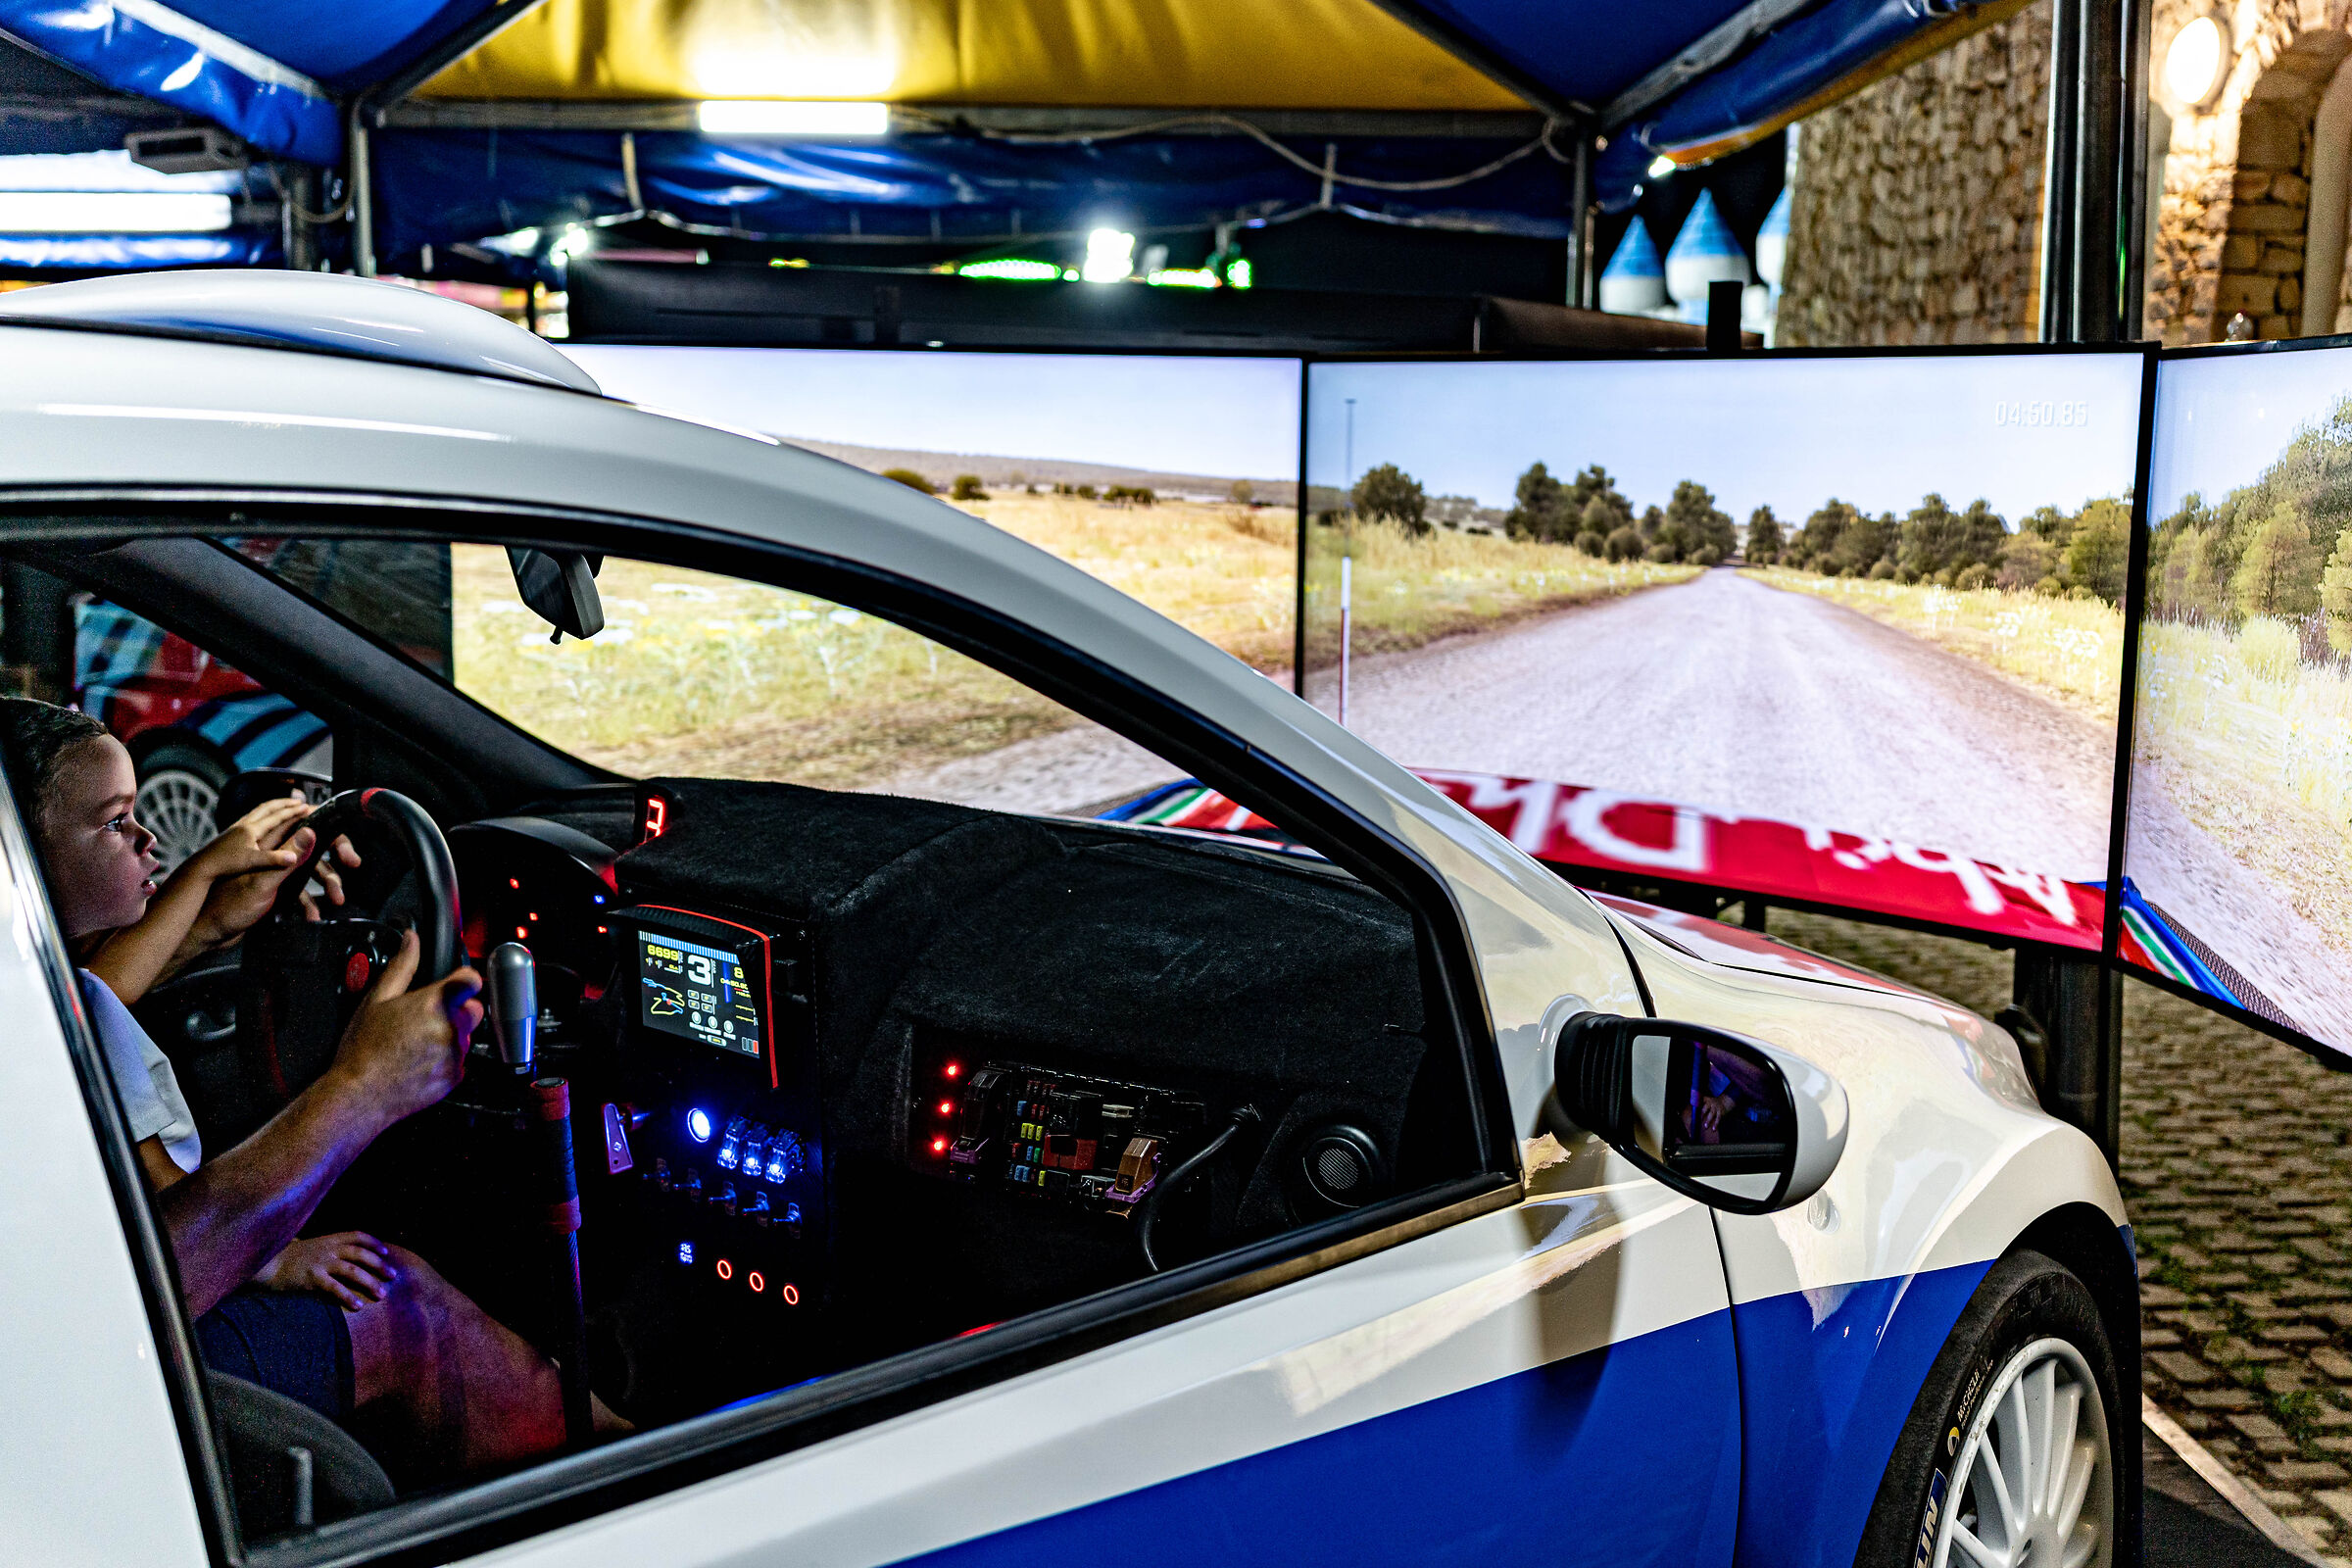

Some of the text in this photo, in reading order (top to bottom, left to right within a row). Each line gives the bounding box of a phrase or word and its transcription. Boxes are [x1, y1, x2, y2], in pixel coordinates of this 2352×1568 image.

[1994, 400, 2089, 427] 04:50.85
[647, 944, 679, 961] 6699
[688, 955, 711, 986] 3
